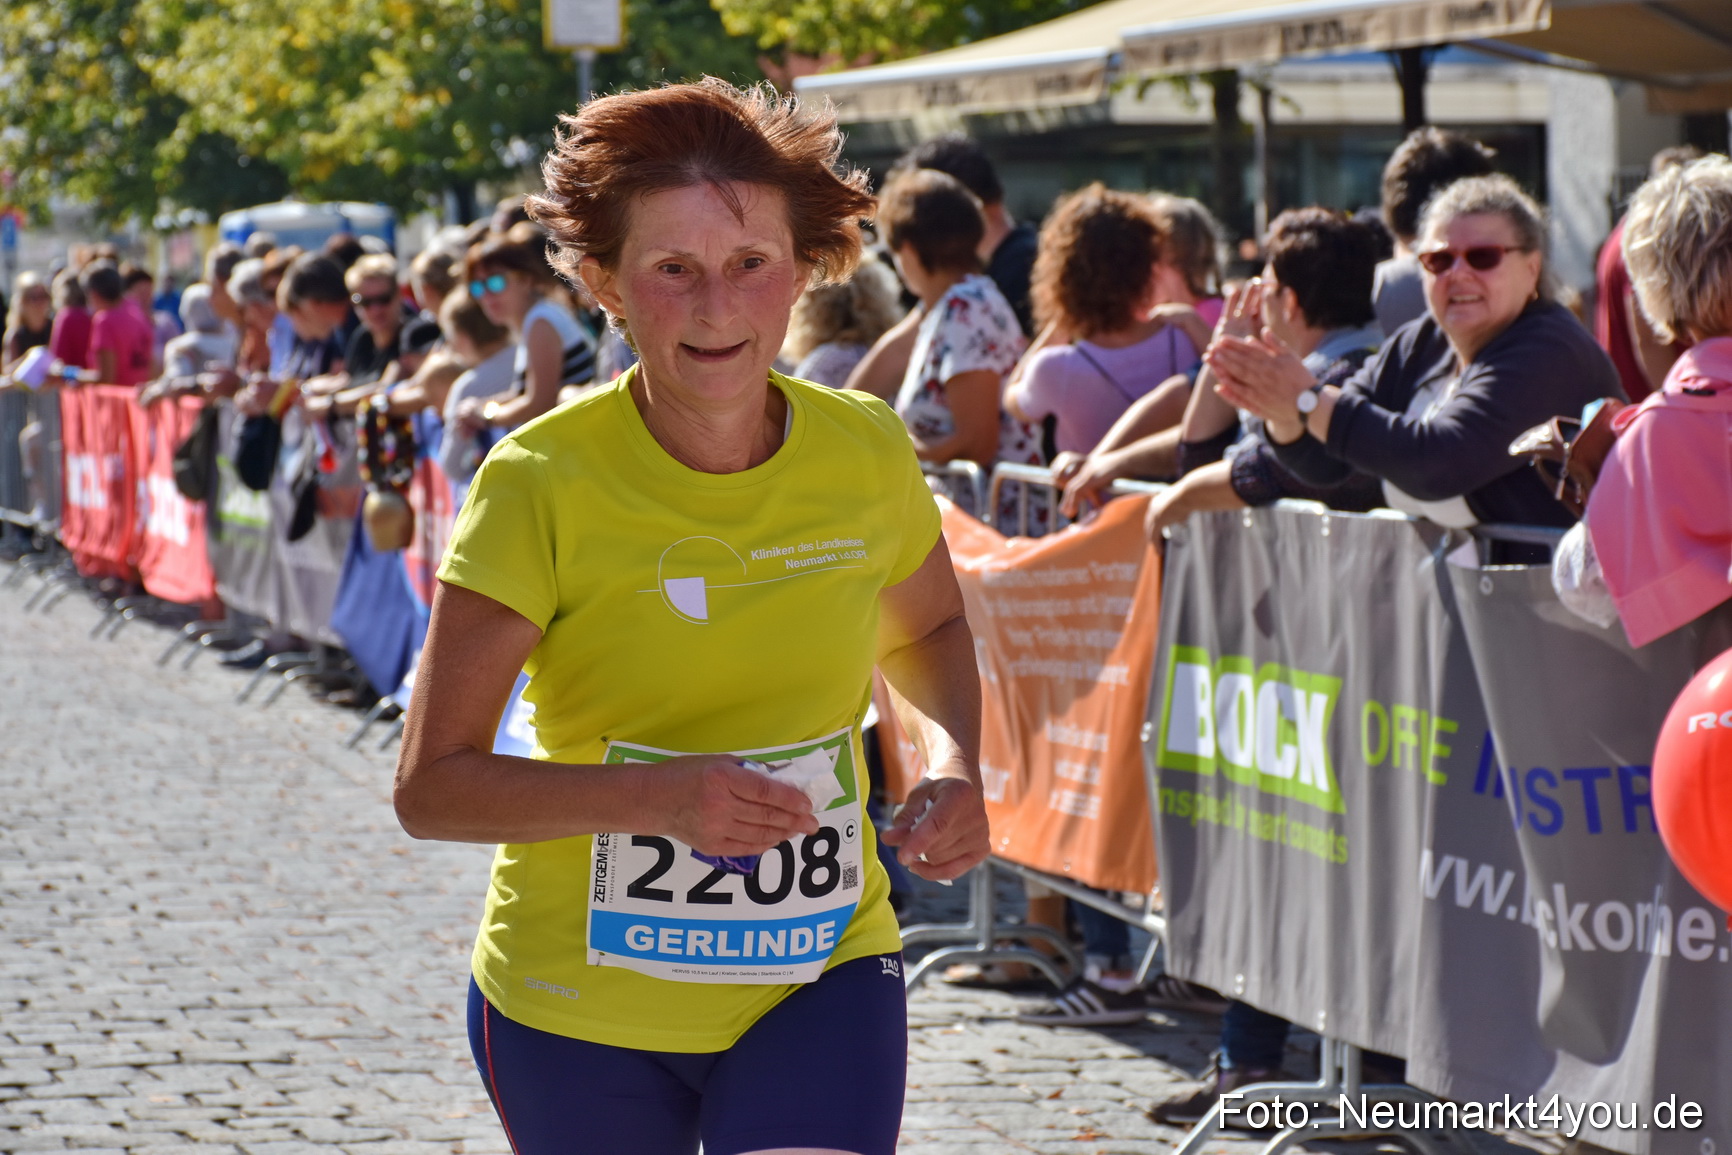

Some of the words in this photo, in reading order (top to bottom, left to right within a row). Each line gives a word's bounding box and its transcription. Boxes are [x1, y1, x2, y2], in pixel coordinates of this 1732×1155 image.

[751, 546, 795, 560] Kliniken
[797, 542, 814, 553] des
[816, 538, 864, 550] Landkreises
[785, 553, 838, 569] Neumarkt
[1166, 661, 1329, 792] BOCK
[846, 825, 854, 838] C
[626, 826, 840, 905] 2208
[624, 920, 836, 957] GERLINDE
[524, 976, 579, 1000] SPIRO
